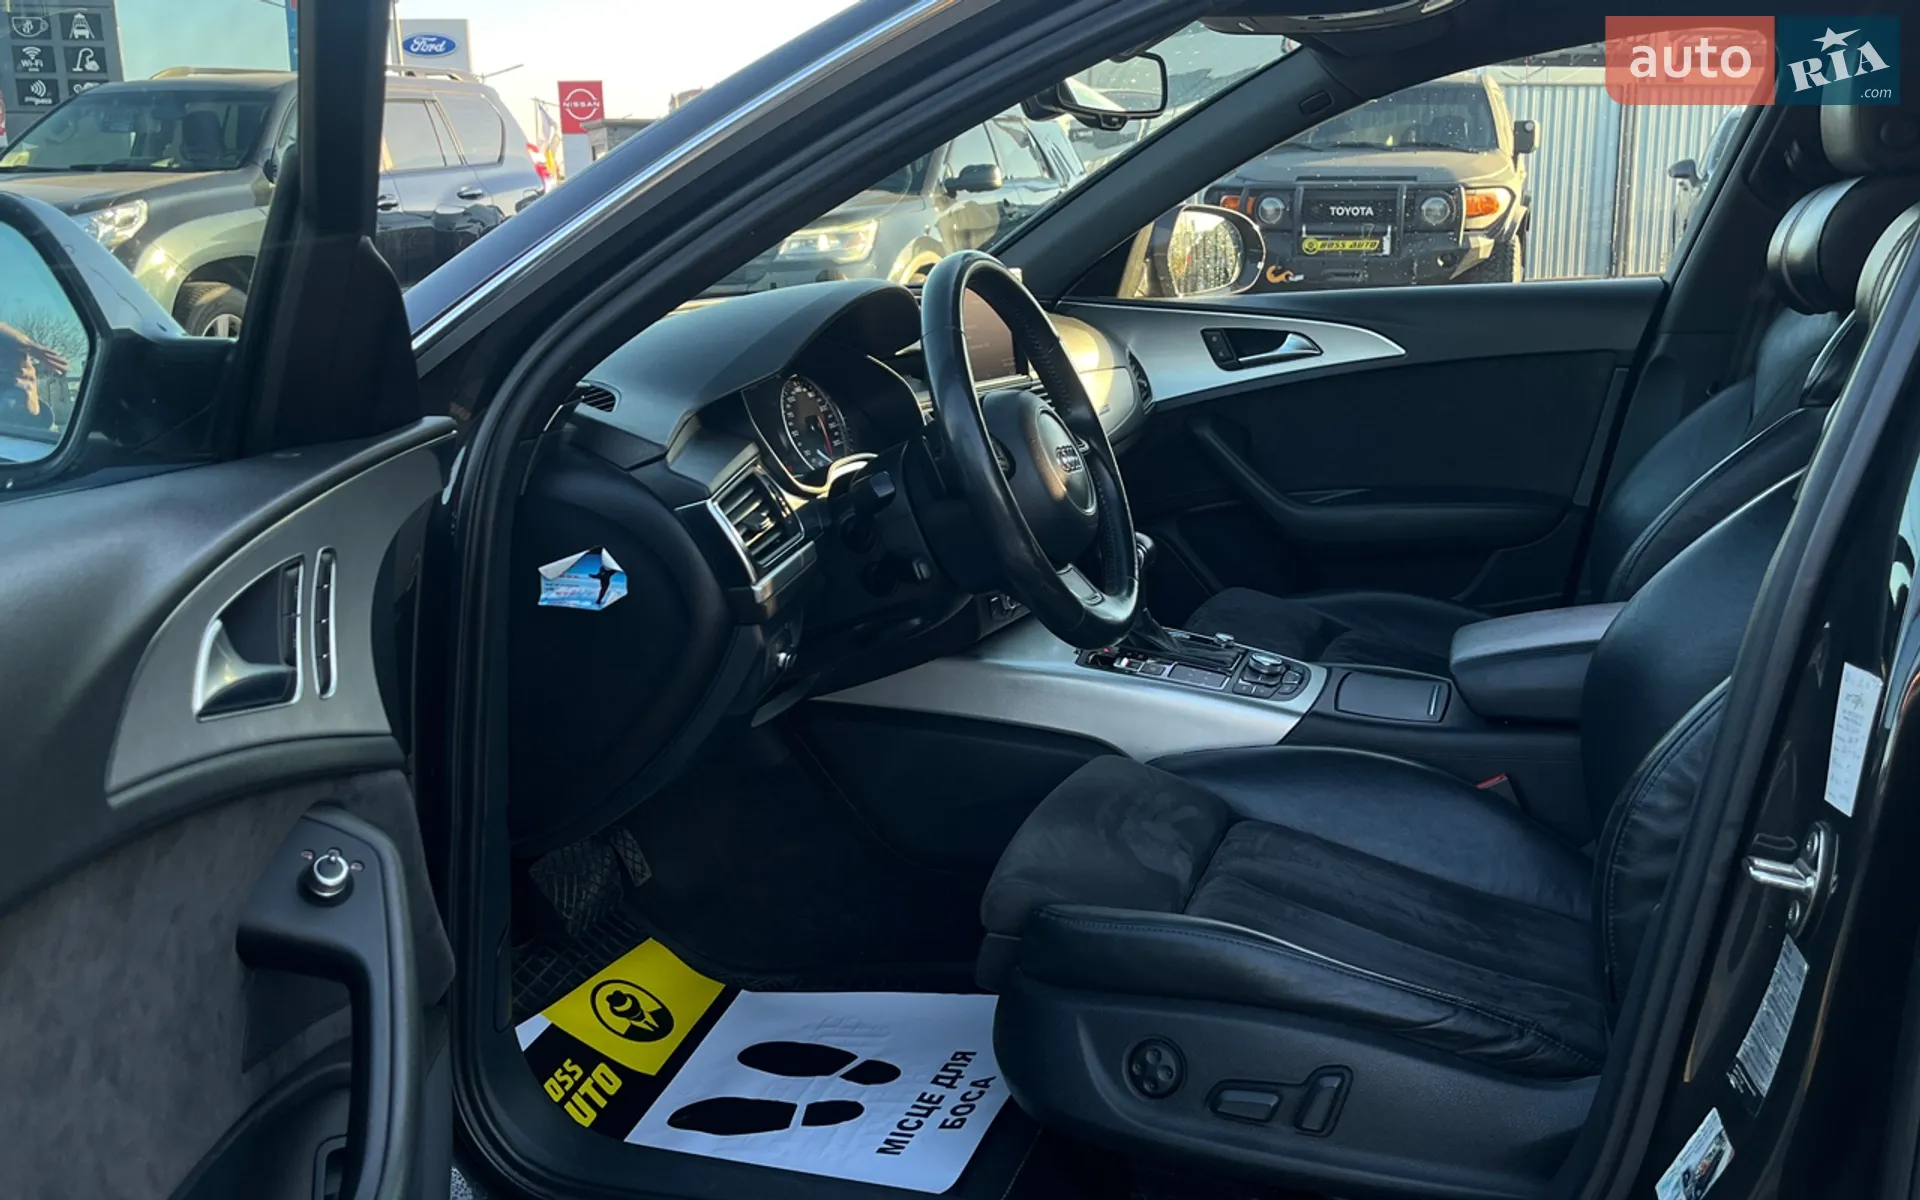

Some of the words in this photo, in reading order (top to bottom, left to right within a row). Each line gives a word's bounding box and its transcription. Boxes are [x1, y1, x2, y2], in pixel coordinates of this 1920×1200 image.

[409, 37, 447, 53] Ford
[1329, 206, 1374, 216] TOYOTA
[543, 1058, 584, 1103] OSS
[930, 1051, 977, 1089] ДЛЯ
[563, 1062, 623, 1128] UTO
